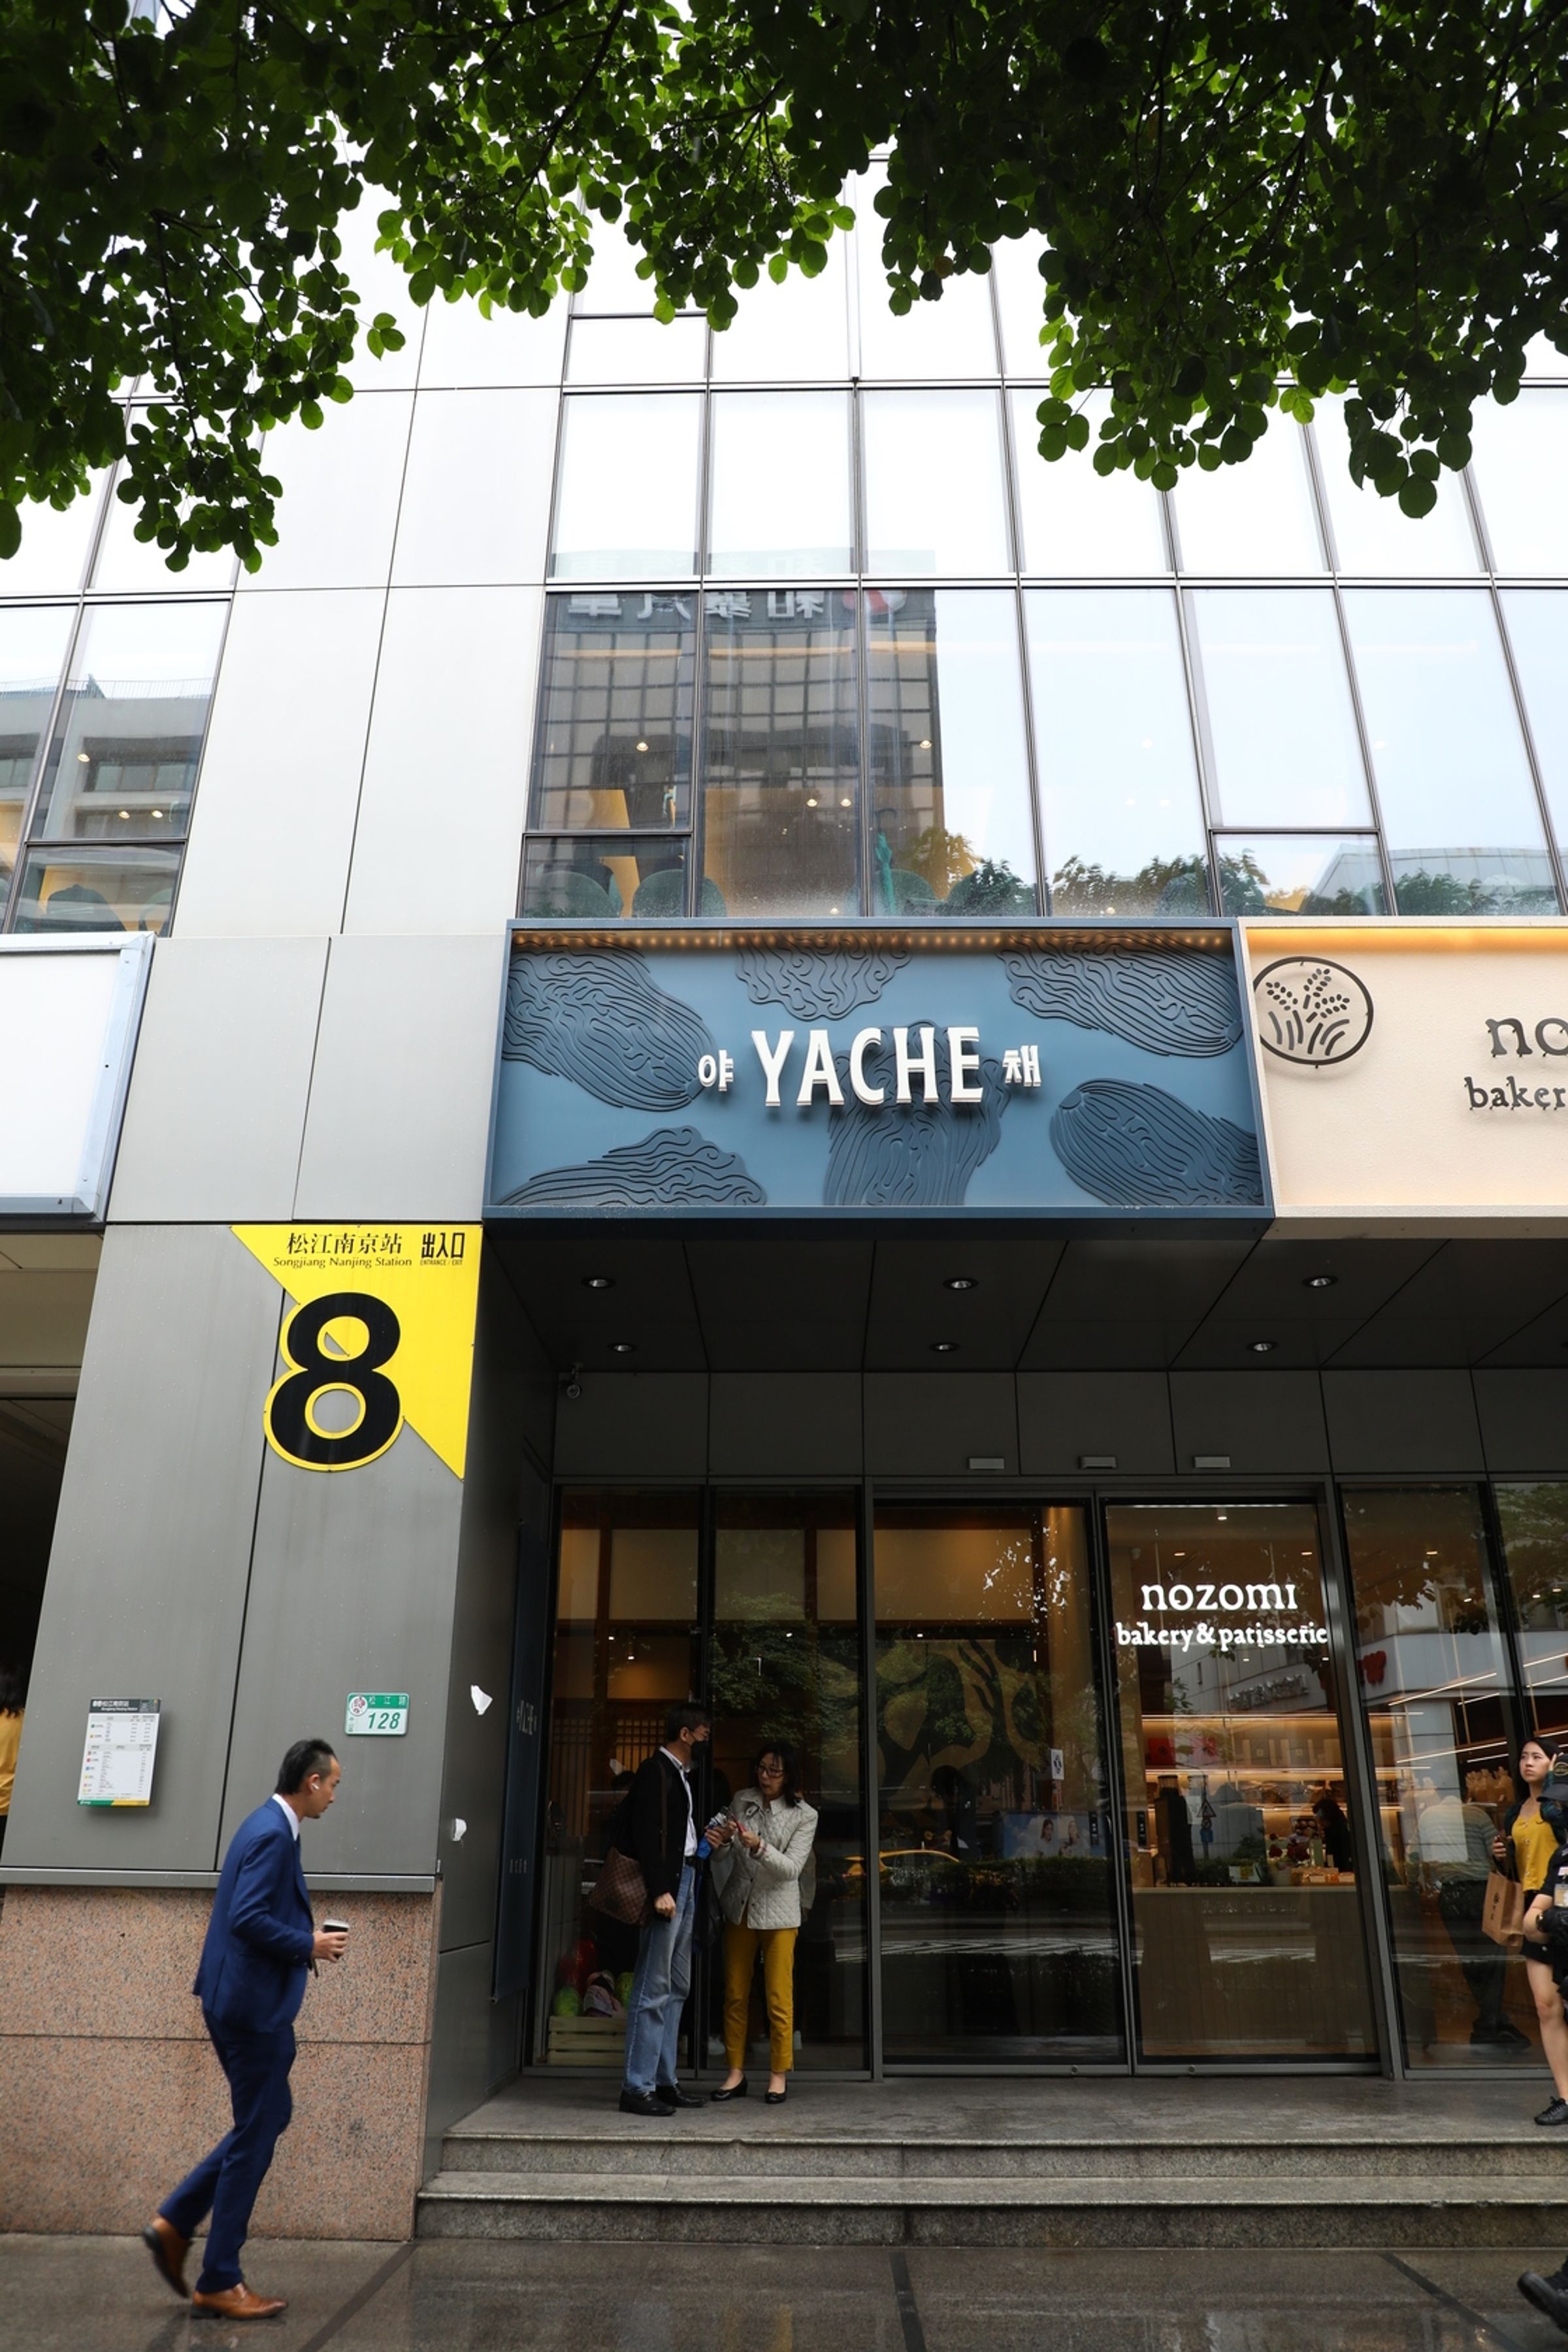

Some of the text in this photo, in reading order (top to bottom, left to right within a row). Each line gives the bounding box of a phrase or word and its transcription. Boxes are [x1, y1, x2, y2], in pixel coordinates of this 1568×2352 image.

[1485, 1017, 1568, 1056] no
[698, 1026, 1041, 1107] 야 YACHE 채
[1464, 1075, 1566, 1110] baker
[286, 1232, 402, 1255] 松江南京站
[421, 1232, 466, 1258] 出入口
[273, 1256, 413, 1269] Songjiang Nanjing Station
[269, 1291, 401, 1465] 8
[1141, 1583, 1298, 1610] nozomi
[368, 1712, 401, 1730] 128
